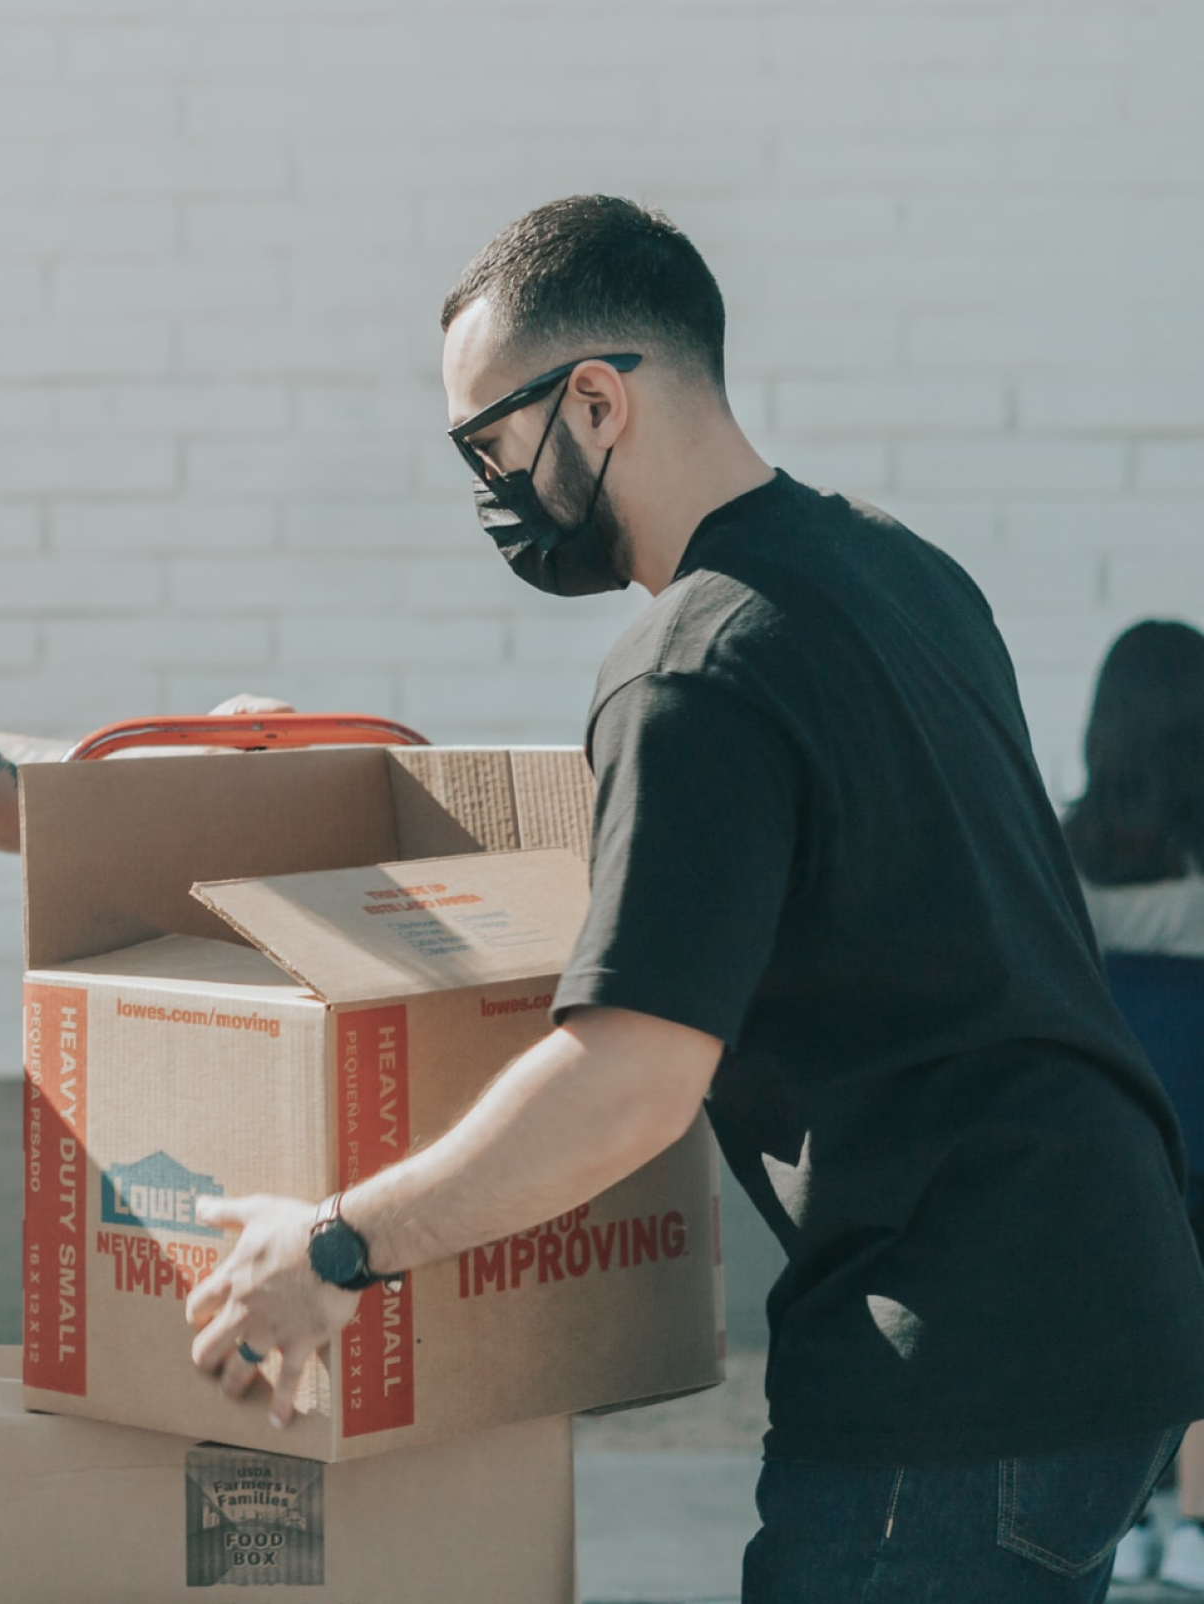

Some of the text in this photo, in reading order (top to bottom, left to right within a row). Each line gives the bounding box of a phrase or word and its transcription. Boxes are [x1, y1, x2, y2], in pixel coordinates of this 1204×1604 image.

[480, 993, 554, 1017] lowes.co
[115, 998, 280, 1038] lowes.com/moving
[378, 1025, 398, 1148] HEAVY
[29, 1107, 41, 1192] PESADO
[347, 1140, 360, 1190] PES
[58, 1006, 77, 1364] HEAVY DUTY SMALL
[113, 1175, 200, 1225] LOWE'
[97, 1231, 218, 1270] NEVER STOP
[29, 1293, 40, 1315] 12
[29, 1342, 40, 1364] 12
[350, 1335, 362, 1357] 12
[350, 1386, 362, 1410] 12
[236, 1467, 272, 1478] USDA
[213, 1480, 283, 1494] Farmers
[216, 1490, 289, 1508] Families
[225, 1532, 284, 1549] FOOD
[232, 1551, 278, 1567] BOX
